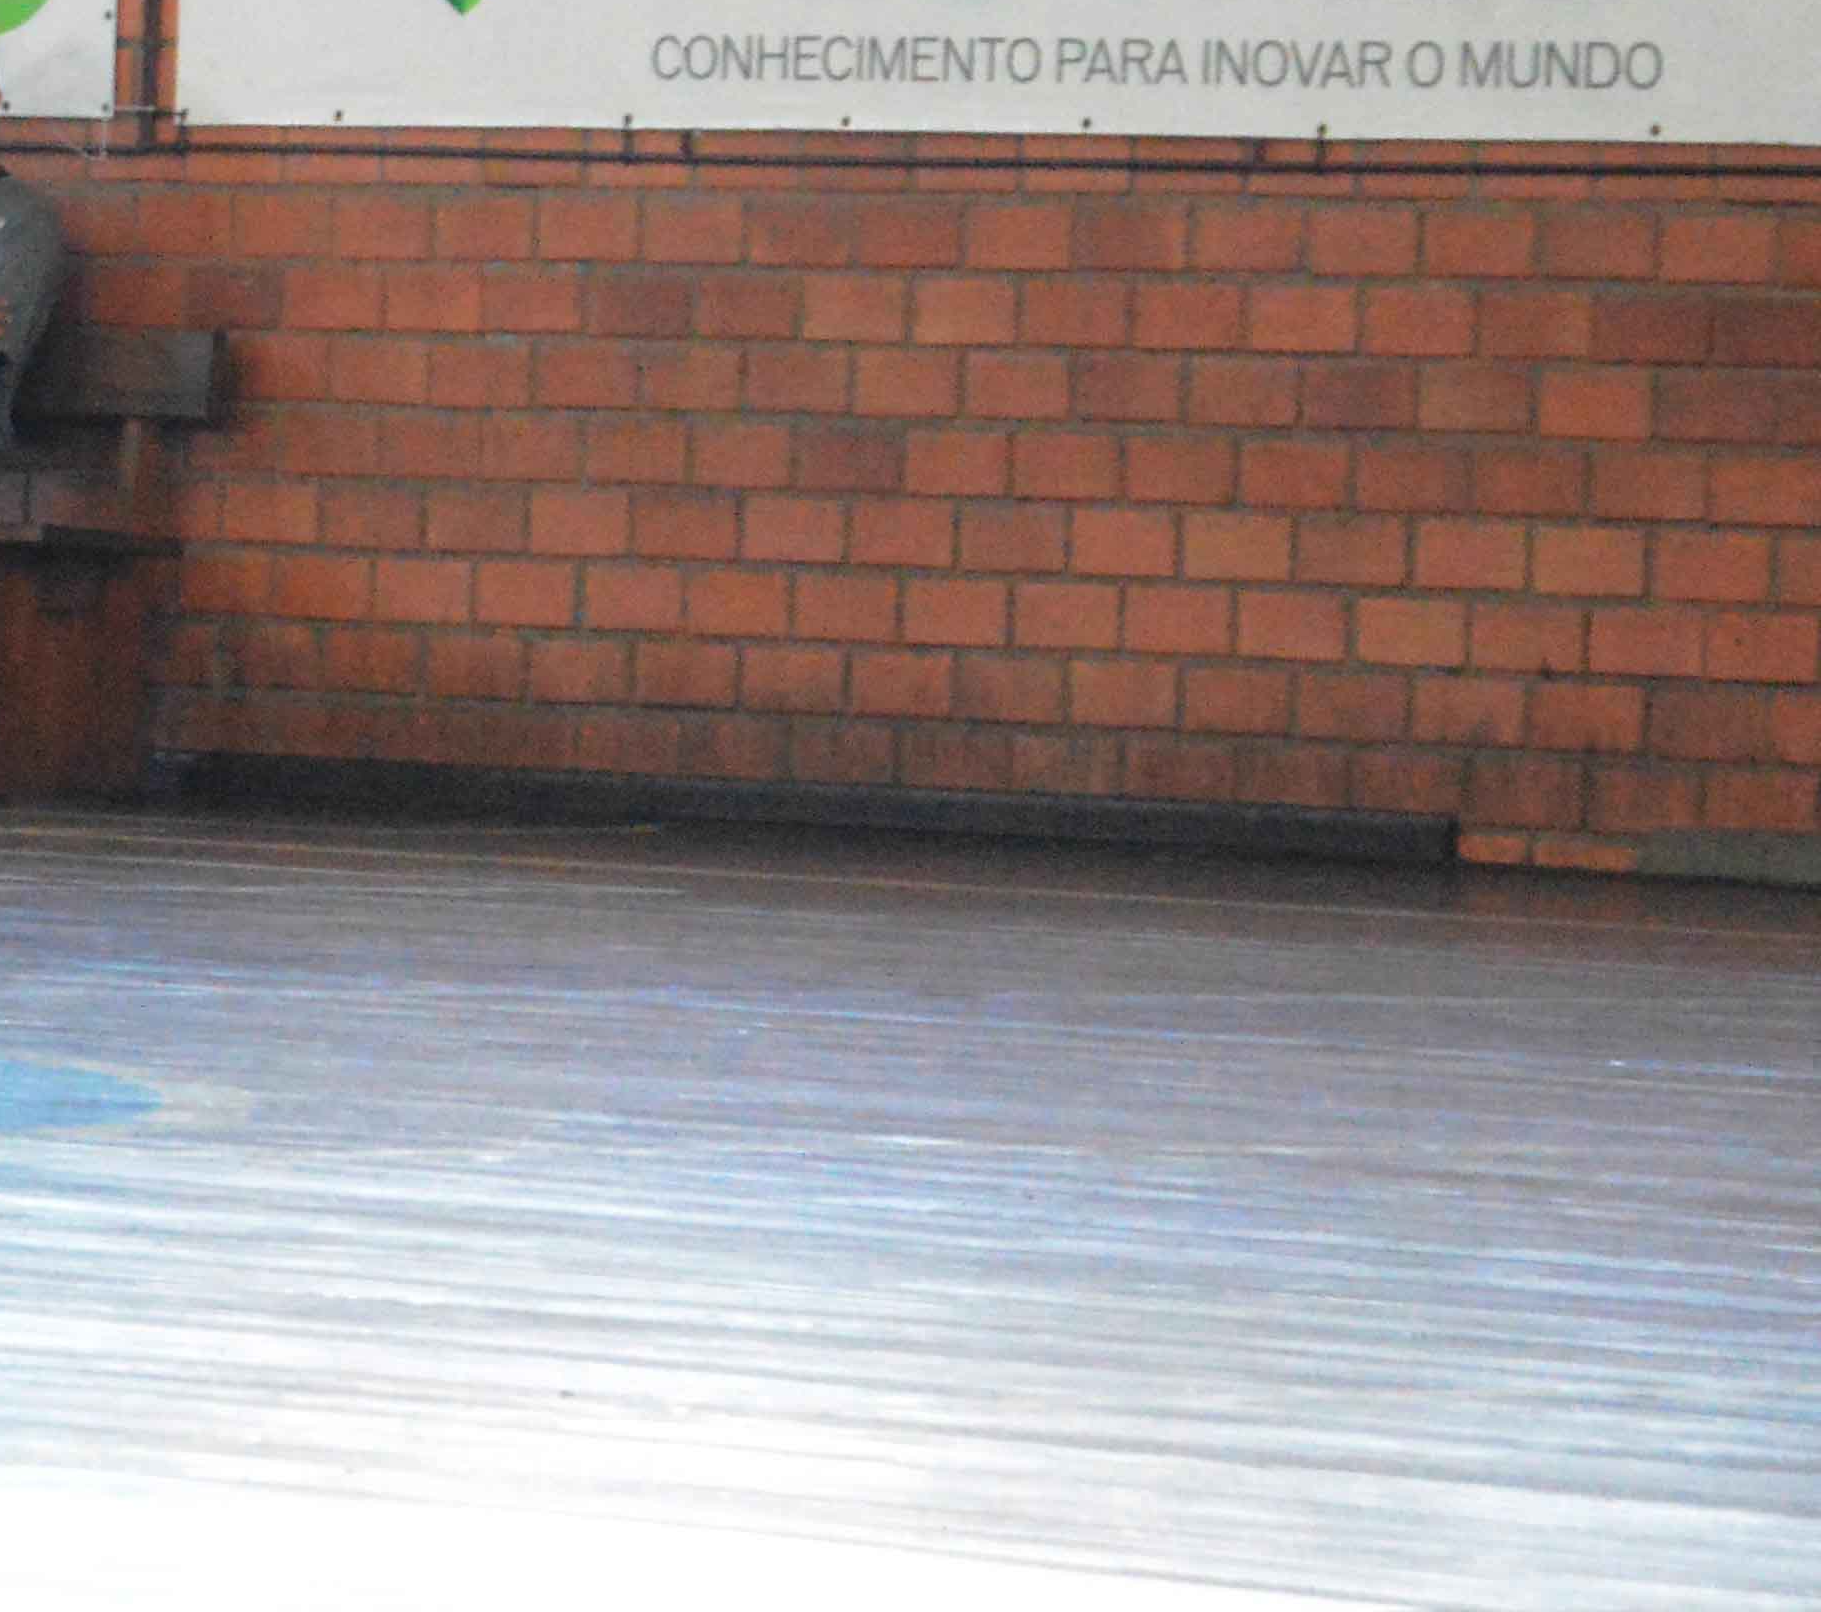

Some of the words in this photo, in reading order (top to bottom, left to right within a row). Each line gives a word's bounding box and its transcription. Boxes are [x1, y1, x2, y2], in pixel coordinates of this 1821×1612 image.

[651, 33, 1042, 87] CONHECIMENTO
[1055, 36, 1184, 87] PARA
[1200, 38, 1390, 89] INOVAR
[1405, 40, 1445, 90] O
[1458, 40, 1664, 92] MUNDO
